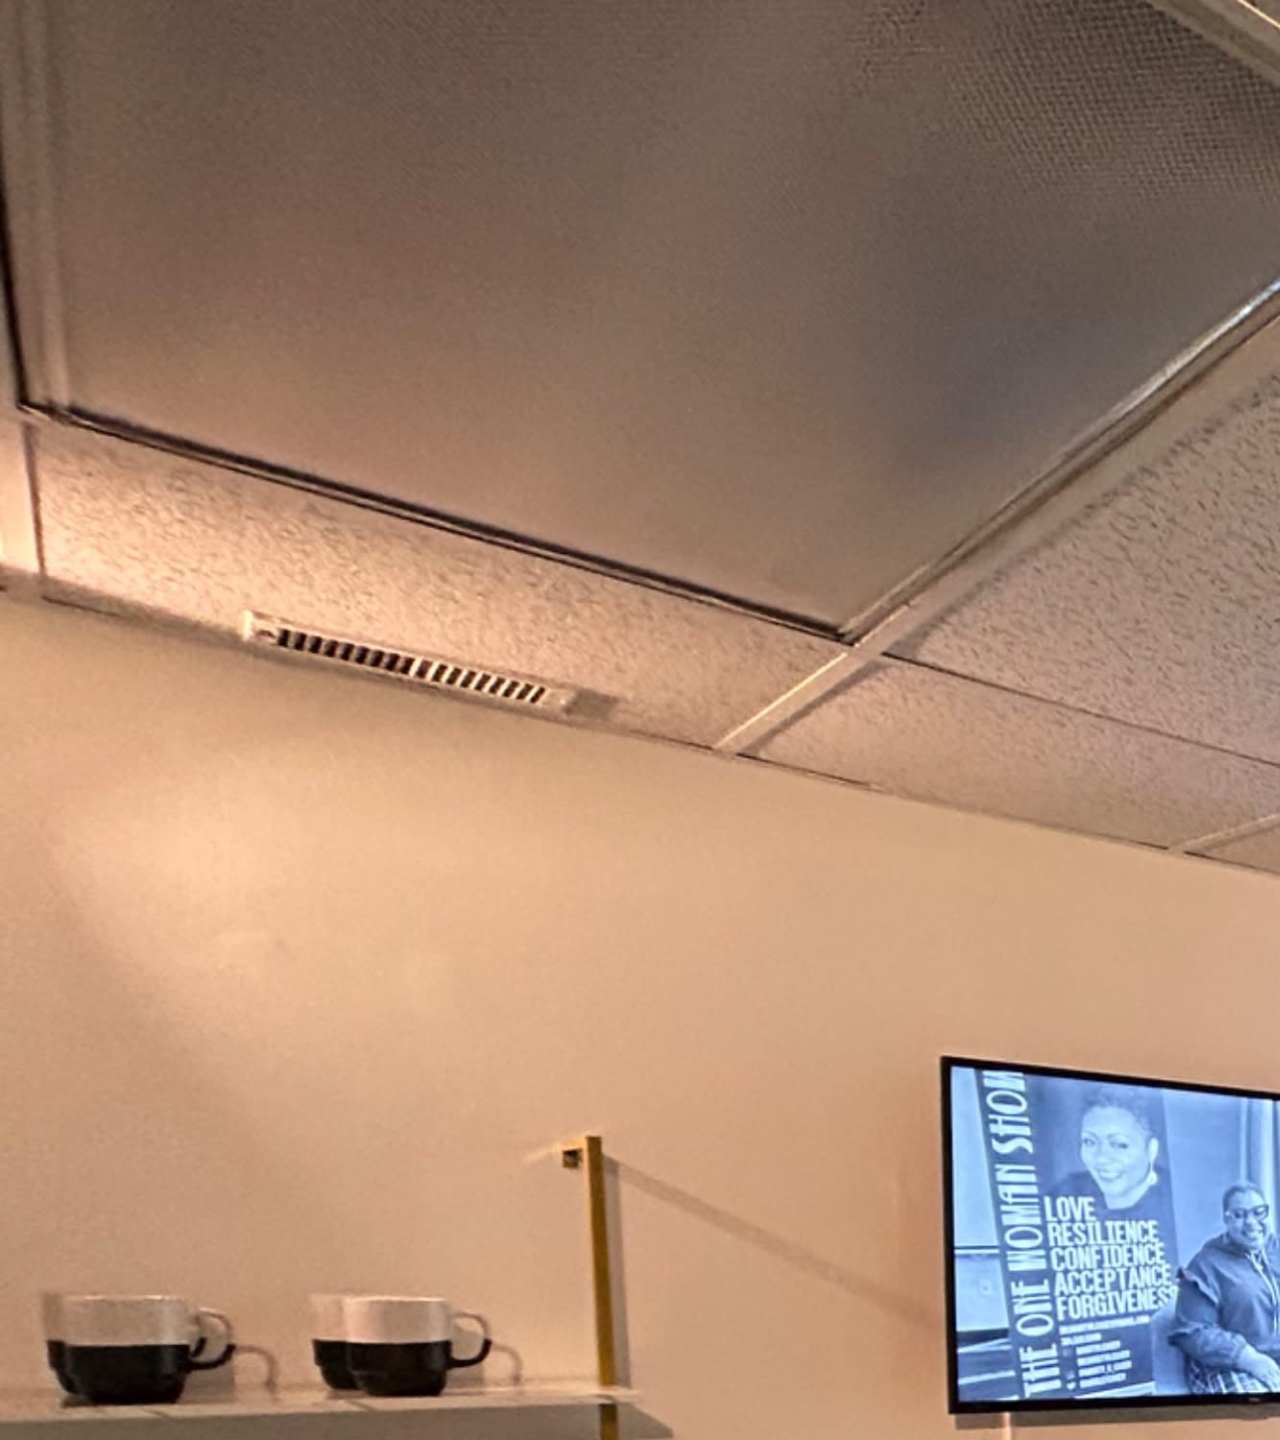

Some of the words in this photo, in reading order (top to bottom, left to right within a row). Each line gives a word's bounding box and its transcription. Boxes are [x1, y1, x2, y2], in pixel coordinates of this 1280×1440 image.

[982, 1070, 1034, 1154] SHOW
[994, 1163, 1048, 1271] WOMAN
[1044, 1195, 1097, 1222] LOVE
[1047, 1219, 1160, 1247] RESILIENCE
[1050, 1242, 1166, 1272] CONFIDENCE
[1054, 1264, 1173, 1297] ACCEPTANCE
[1010, 1278, 1054, 1337] ONE
[1018, 1342, 1062, 1398] THE
